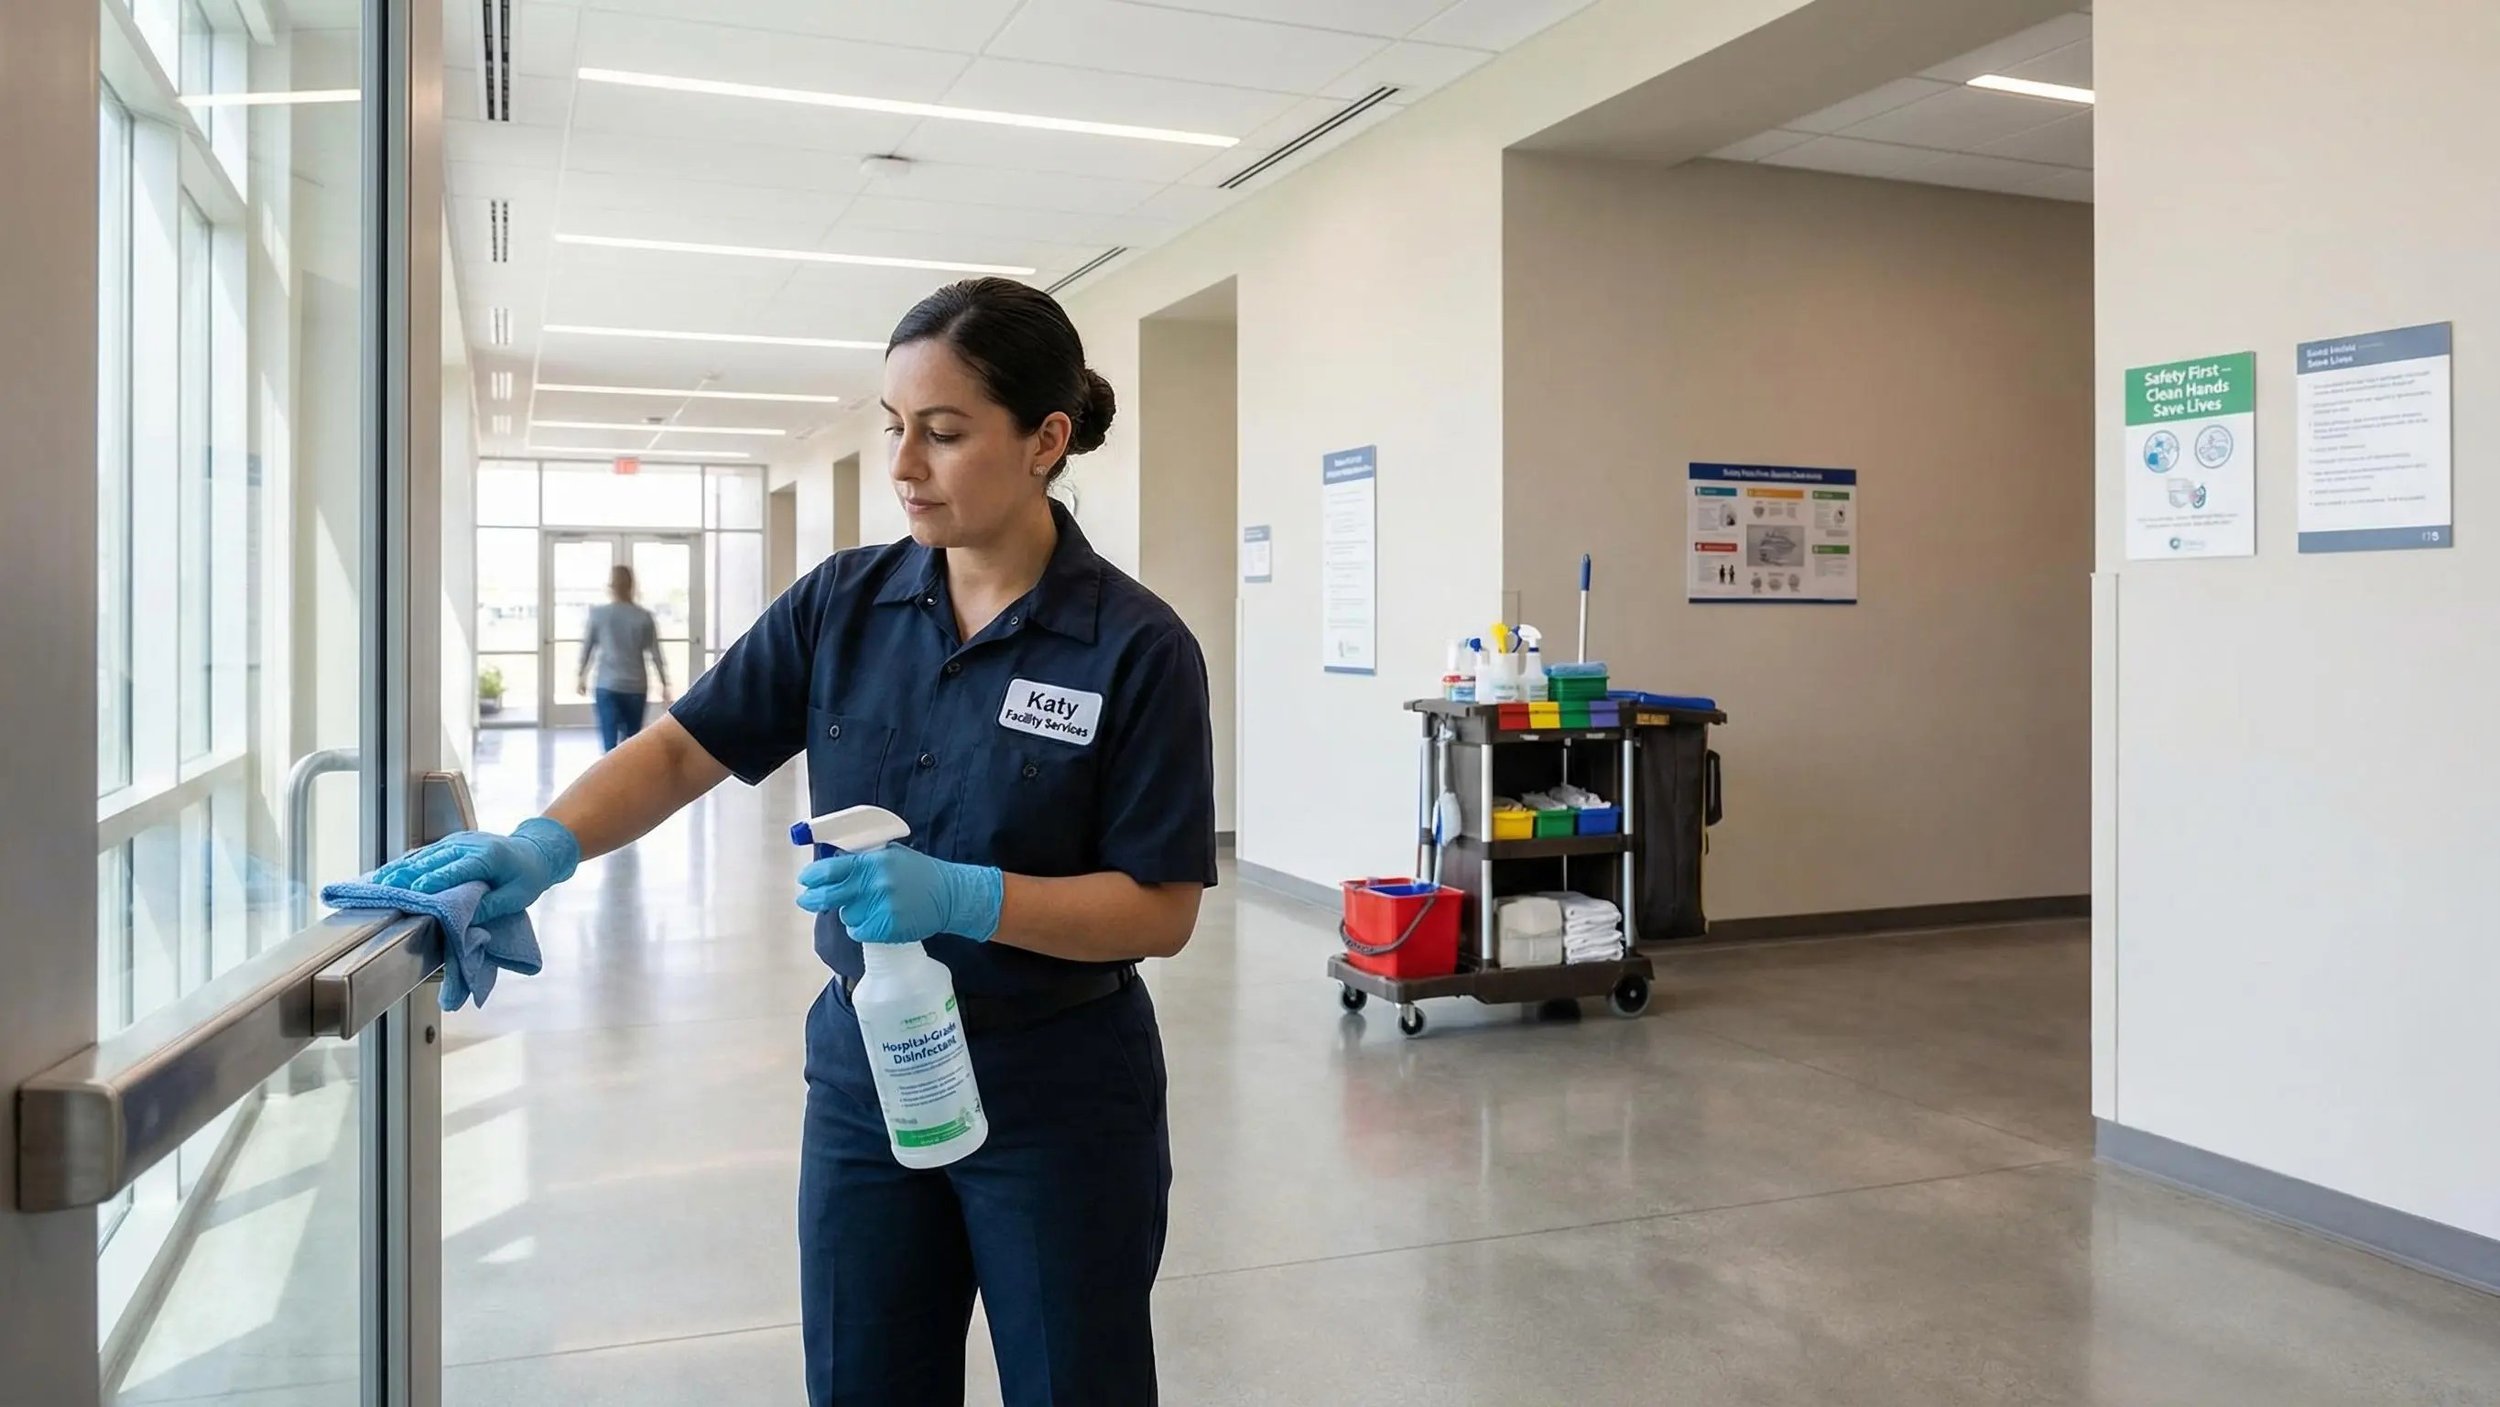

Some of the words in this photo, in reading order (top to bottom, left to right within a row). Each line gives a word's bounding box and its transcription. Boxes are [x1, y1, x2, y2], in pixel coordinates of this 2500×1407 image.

[2144, 369, 2186, 386] Safety
[2188, 364, 2219, 380] First
[2146, 387, 2183, 402] Clean
[2186, 378, 2230, 397] Hands
[2153, 403, 2185, 417] Save
[2187, 398, 2222, 413] Lives
[1027, 691, 1079, 720] Katy
[1045, 718, 1088, 737] Services
